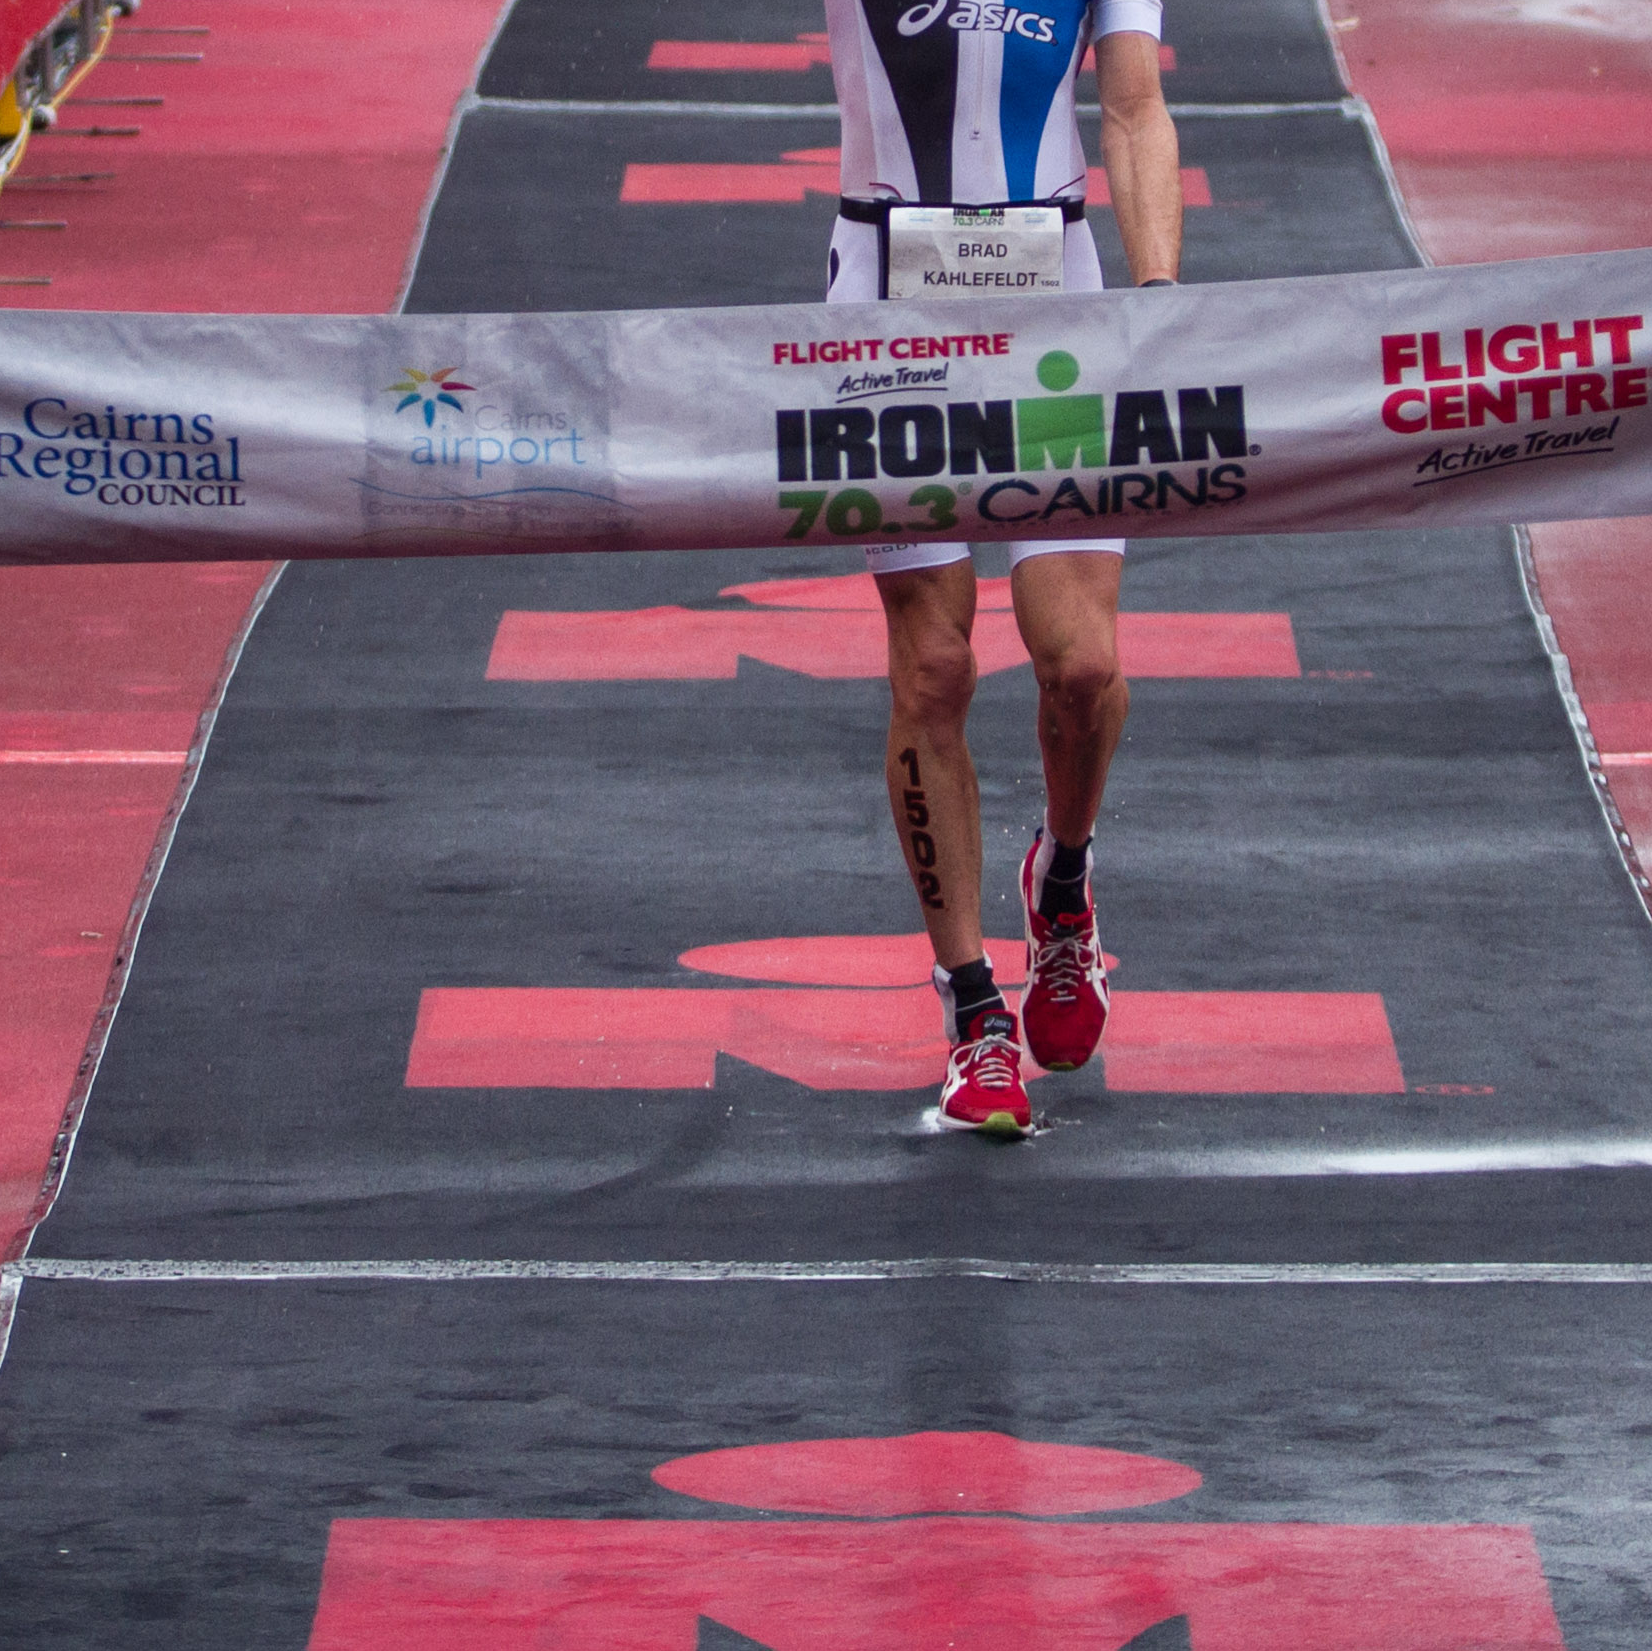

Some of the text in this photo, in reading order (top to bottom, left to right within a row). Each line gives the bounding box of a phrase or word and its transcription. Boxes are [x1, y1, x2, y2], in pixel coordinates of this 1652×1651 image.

[947, 0, 1056, 43] asics
[958, 243, 1008, 258] BRAD
[923, 270, 1038, 287] KAHLEFELDT
[774, 334, 1011, 364] FLIGHT CENTRE
[1380, 315, 1644, 385] FLIGHT
[838, 362, 950, 394] Active Travel
[1381, 367, 1648, 434] CENTRE
[23, 397, 215, 446] Cairns
[474, 404, 569, 431] Cairns
[776, 384, 1249, 482] IRONMAN
[410, 425, 586, 480] airport
[1416, 415, 1621, 475] Active Travel
[97, 481, 247, 508] COUNCIL
[779, 484, 958, 540] 70.3
[977, 463, 1248, 523] CAIRNS
[898, 747, 944, 910] 1502
